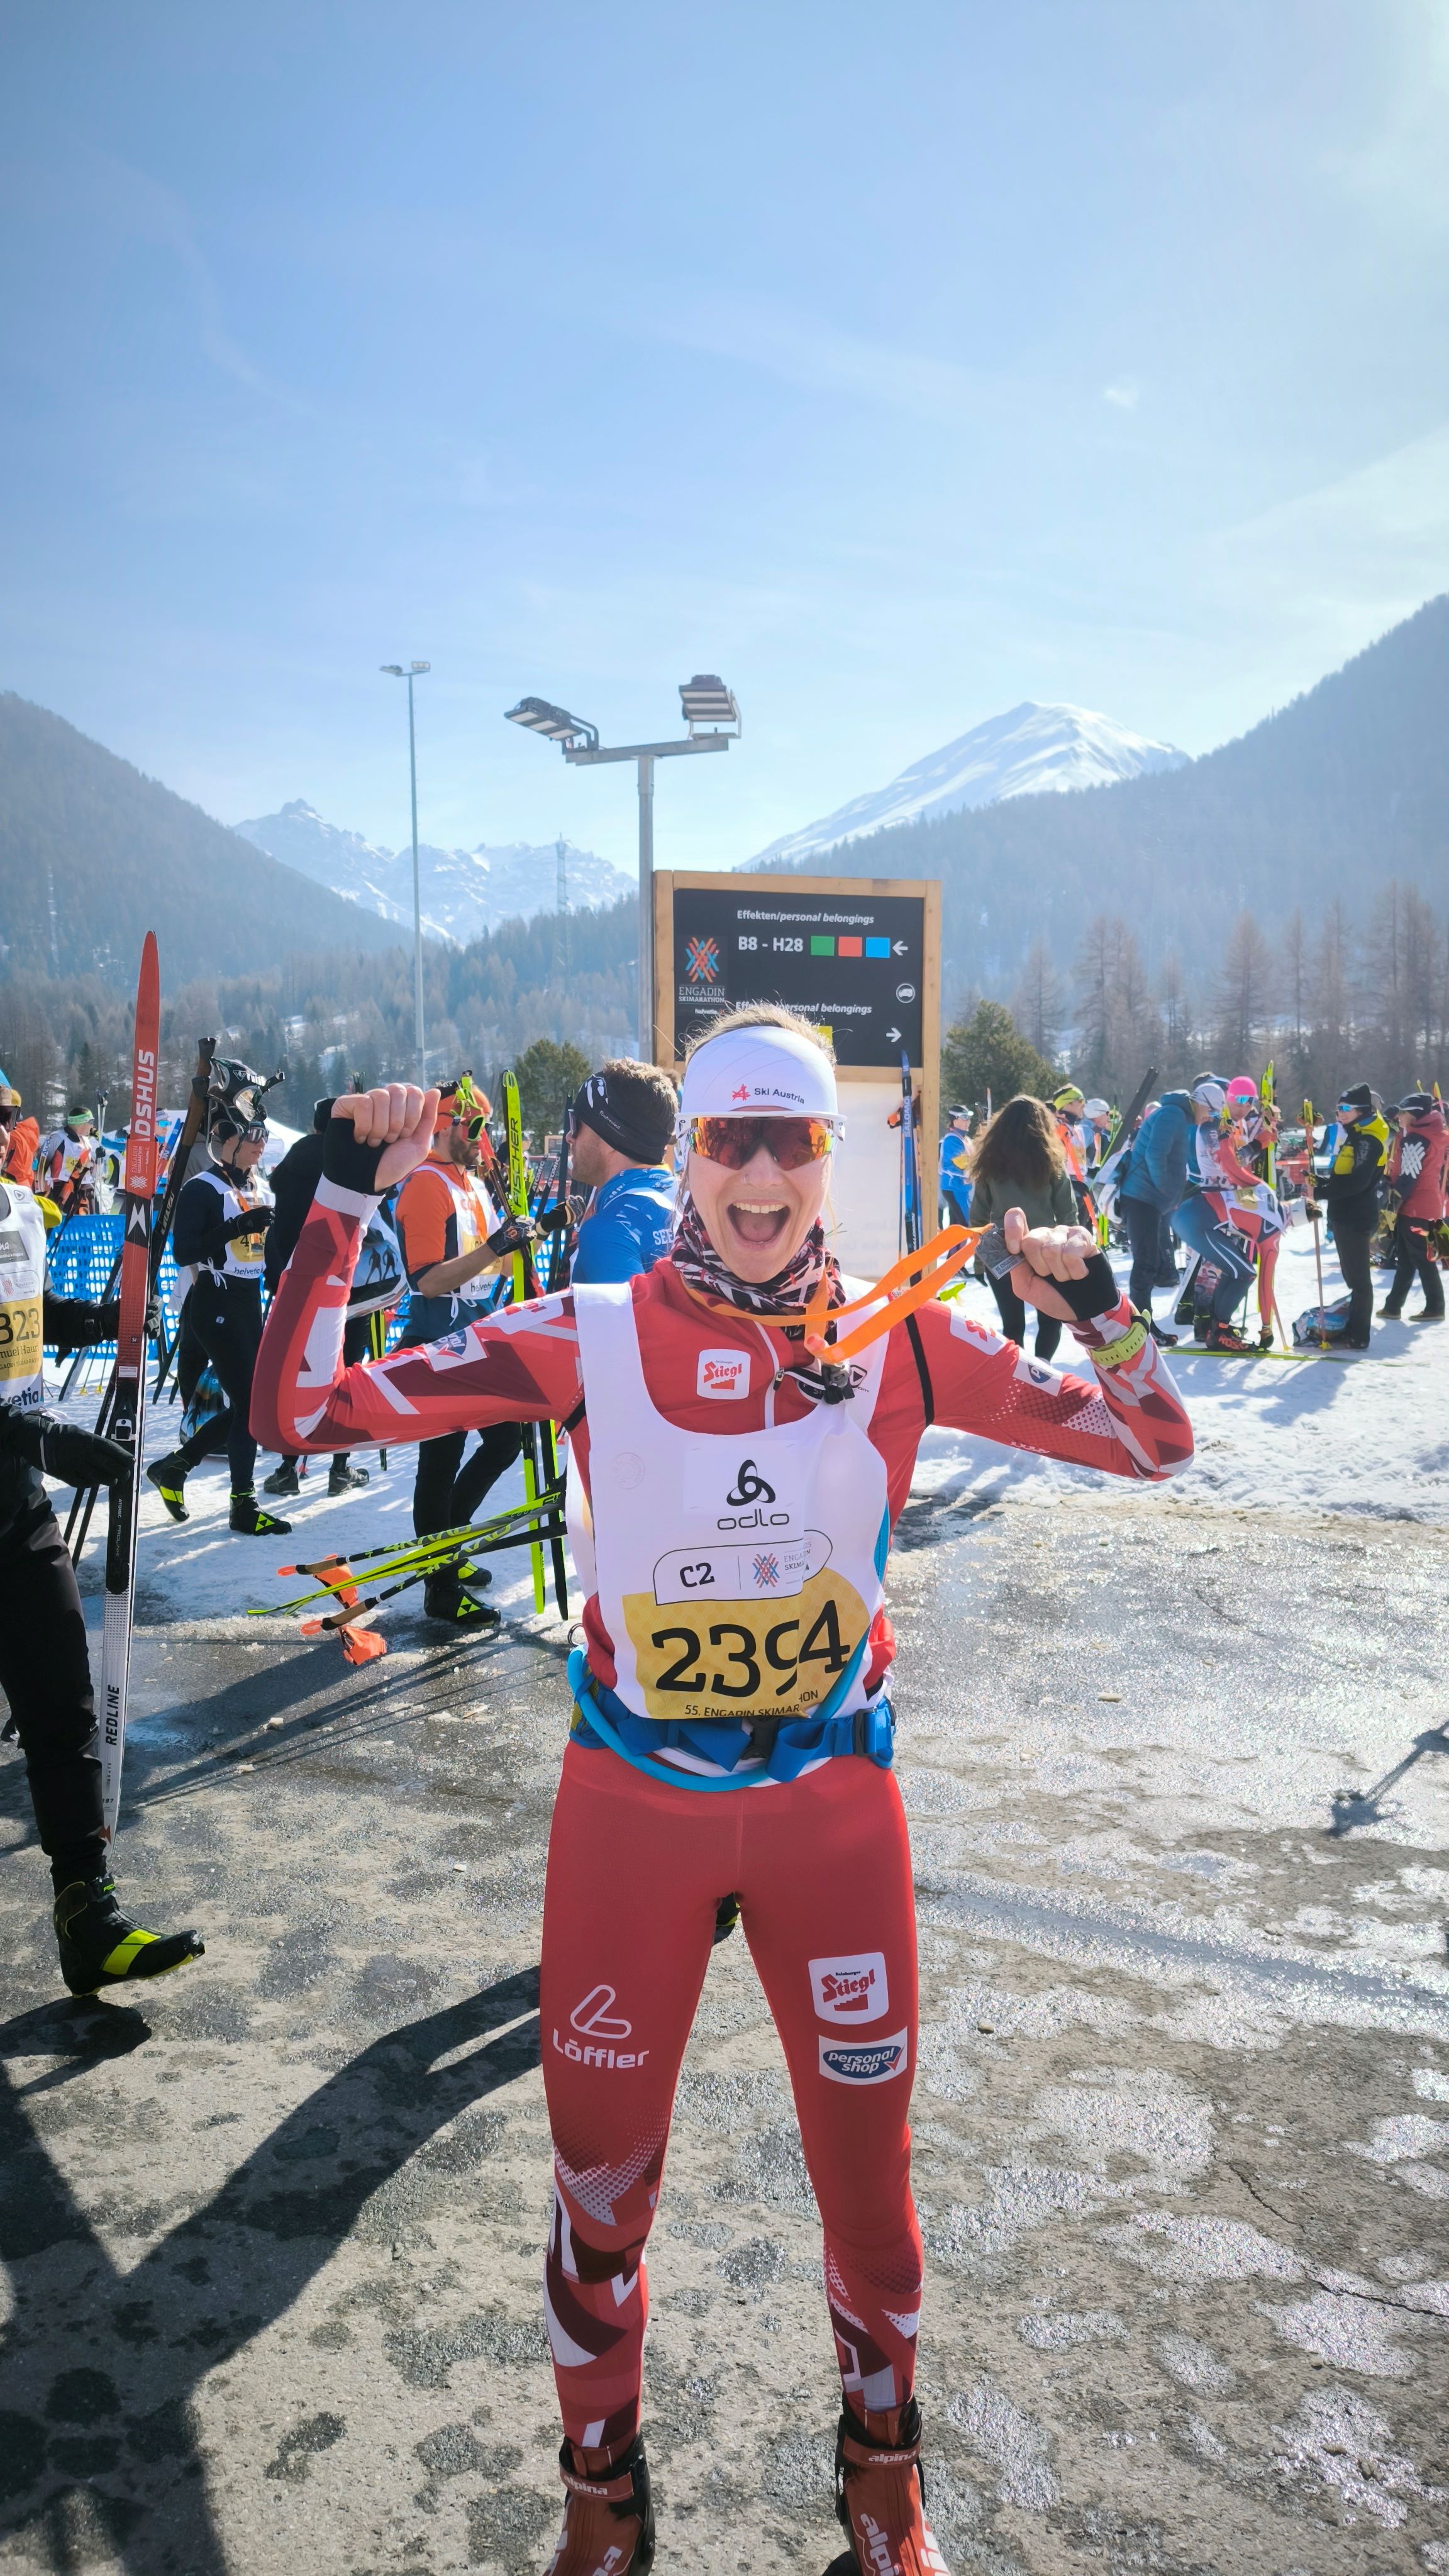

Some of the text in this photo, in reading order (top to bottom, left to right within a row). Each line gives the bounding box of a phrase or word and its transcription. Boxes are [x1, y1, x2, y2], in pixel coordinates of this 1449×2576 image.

[736, 909, 875, 925] Effekten/personal belongings
[738, 936, 757, 950] B8
[773, 937, 804, 952] H28
[679, 986, 725, 997] ENGADIN
[821, 1002, 872, 1015] belongings
[134, 1049, 155, 1141] DSHUS
[754, 1087, 804, 1104] Ski Austria
[510, 1118, 522, 1208] FISCHER
[547, 1157, 560, 1188] ATOMIC
[532, 1160, 545, 1192] ATOMIC
[704, 1361, 742, 1383] Stiegl
[717, 1508, 790, 1530] odlo
[680, 1562, 715, 1588] C2
[105, 1684, 119, 1746] REDLINE
[684, 1704, 701, 1716] 55.
[821, 1968, 875, 2003] Stiegl
[828, 2047, 894, 2065] personal
[841, 2061, 879, 2074] shop
[868, 2450, 916, 2464] alpina
[564, 2474, 609, 2496] alpina
